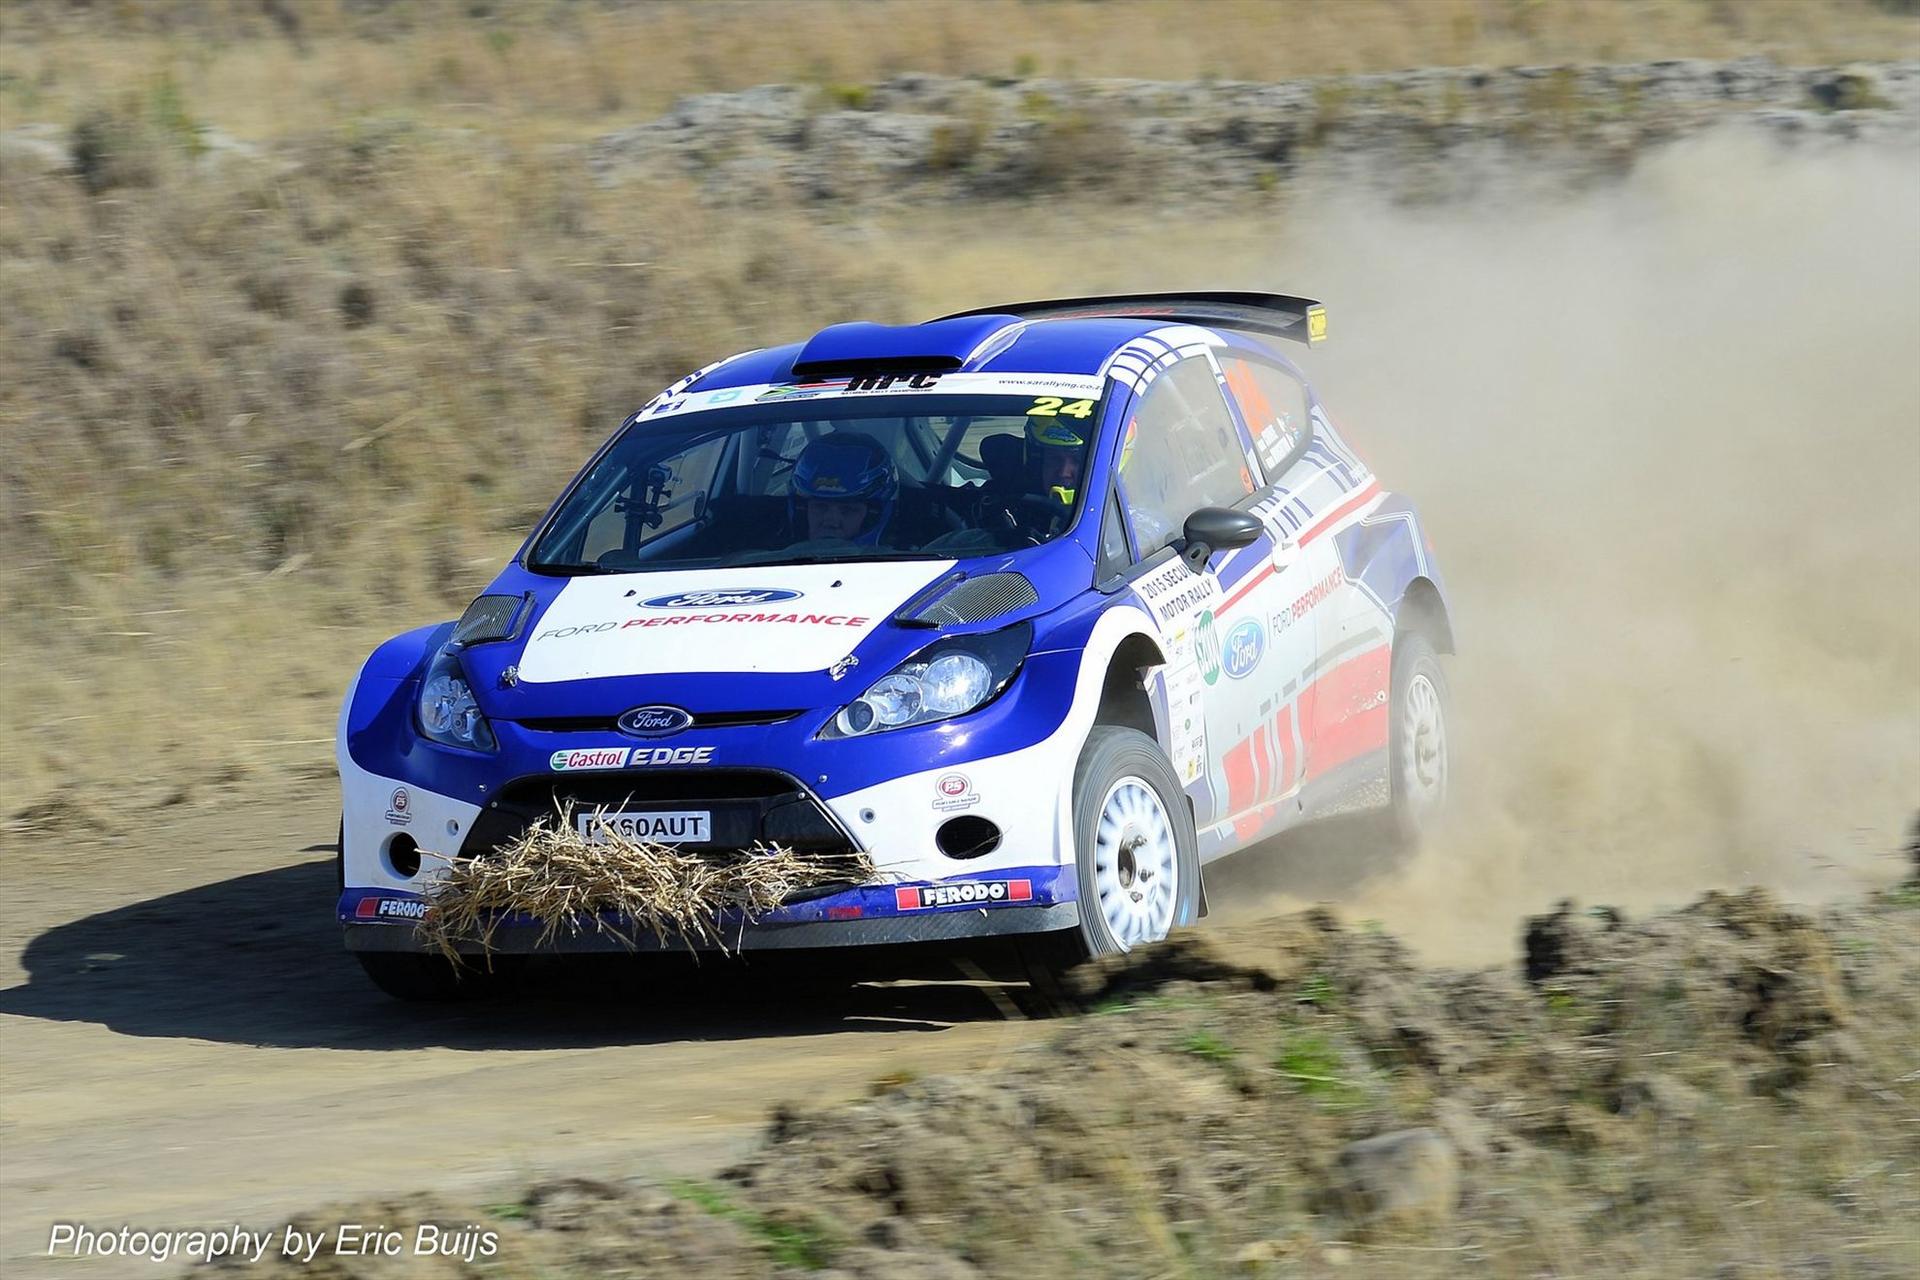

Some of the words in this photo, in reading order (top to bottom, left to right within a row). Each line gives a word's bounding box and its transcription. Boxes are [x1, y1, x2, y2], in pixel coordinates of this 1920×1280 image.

[1026, 397, 1094, 418] 24
[664, 588, 770, 607] Ford
[1142, 577, 1167, 599] 2015
[1159, 593, 1191, 622] MOTOR
[1187, 578, 1214, 606] RALLY
[1273, 607, 1292, 636] FORD
[1291, 566, 1343, 622] PERFORMANCE
[537, 620, 617, 642] FORD
[620, 614, 867, 629] PERFORMANCE
[1232, 628, 1257, 672] Ford
[632, 710, 673, 729] Ford
[569, 751, 623, 767] Castrol
[629, 747, 716, 766] EDGE
[924, 884, 1005, 906] FERODO
[378, 900, 426, 918] FERODO
